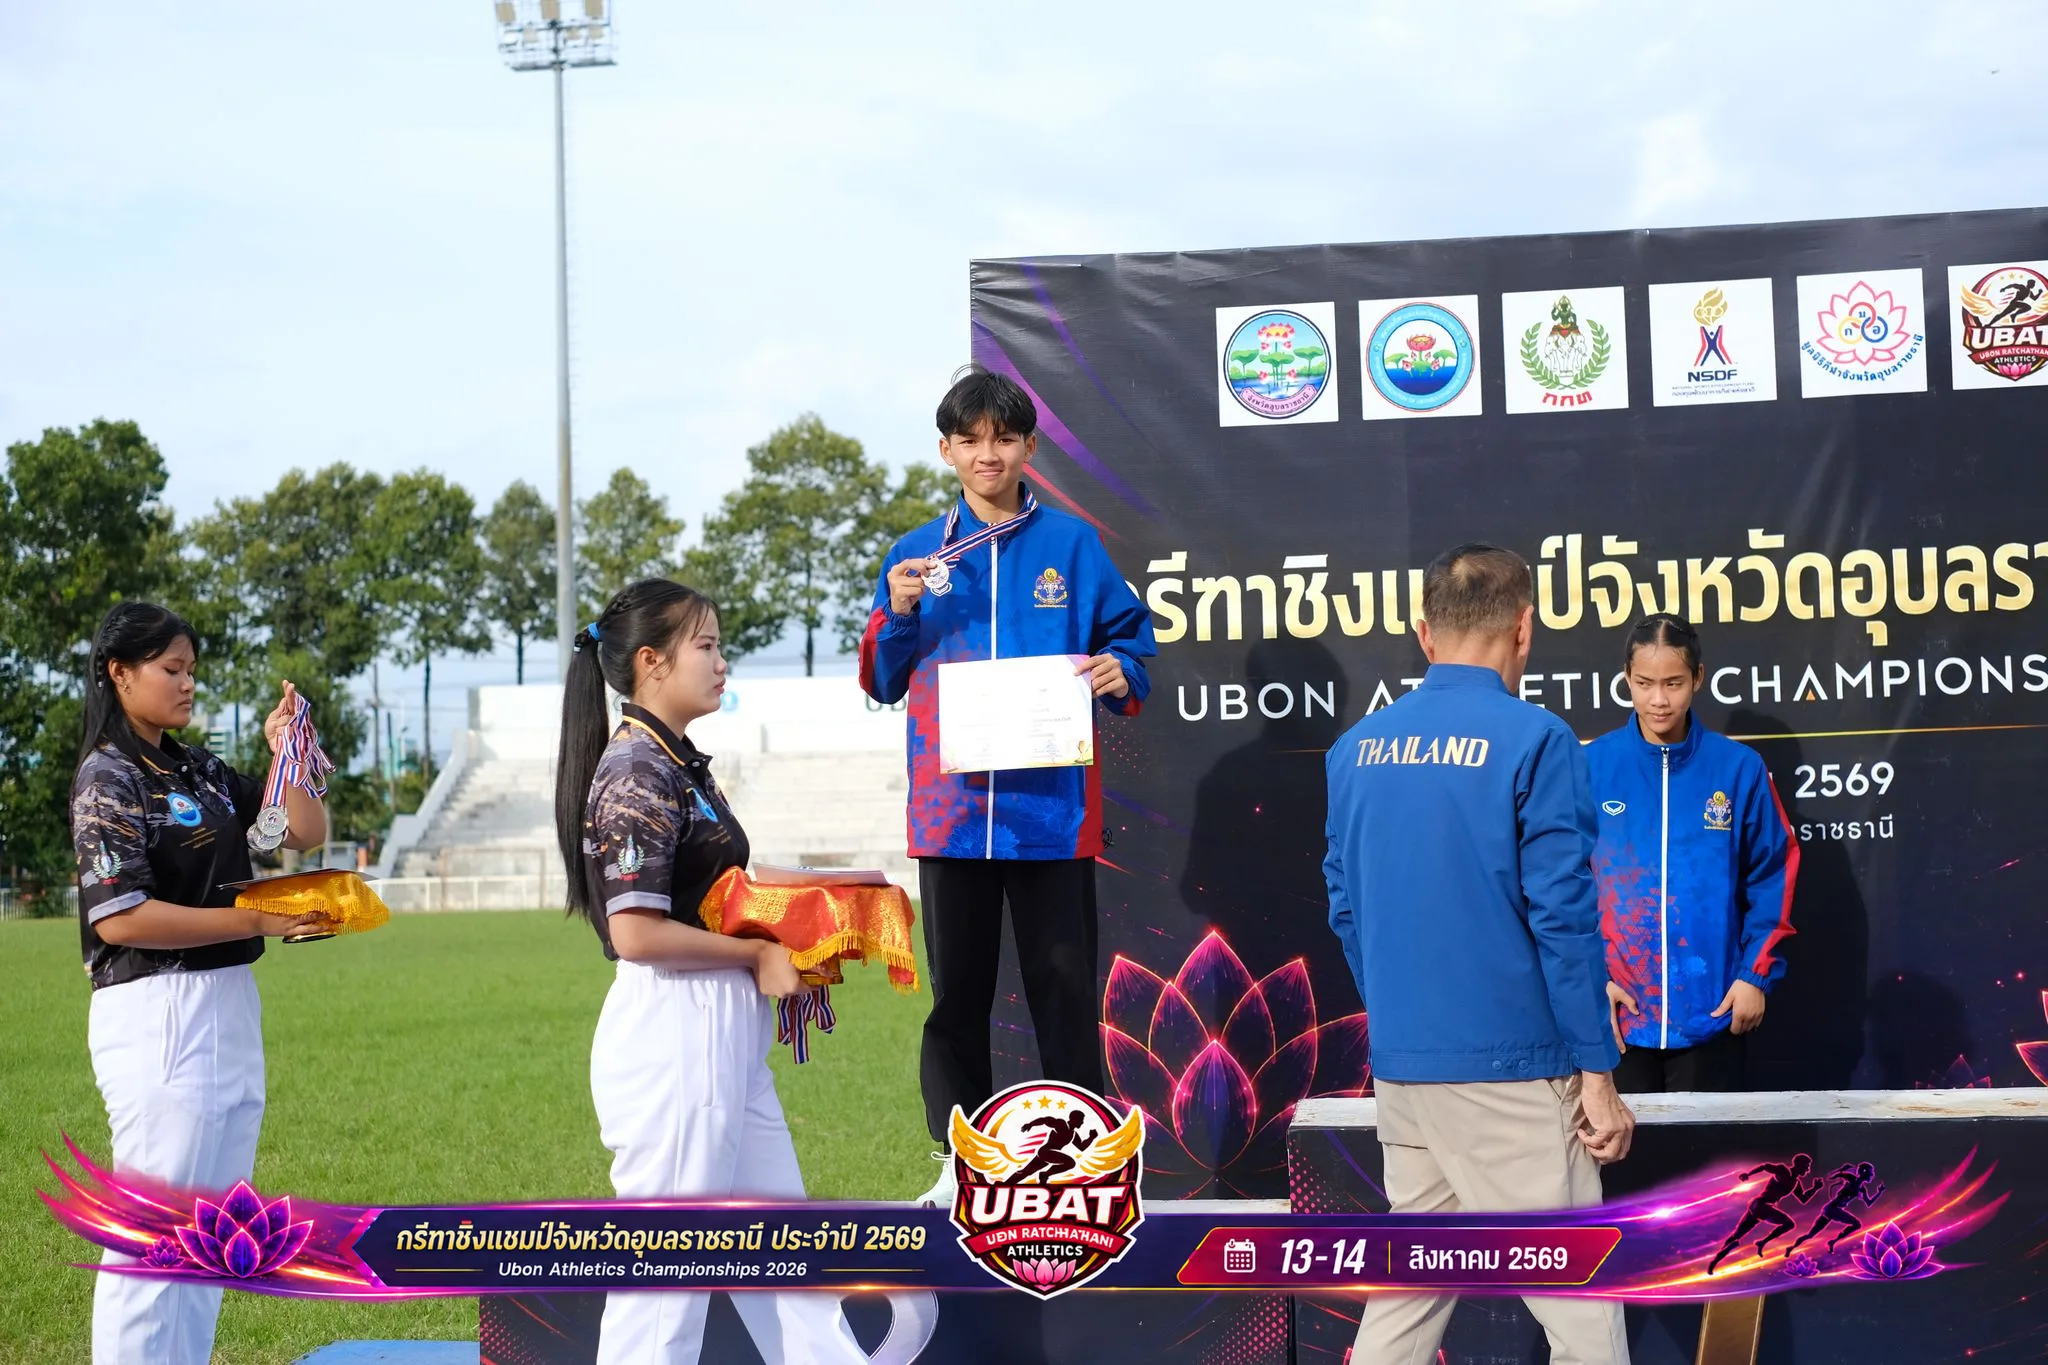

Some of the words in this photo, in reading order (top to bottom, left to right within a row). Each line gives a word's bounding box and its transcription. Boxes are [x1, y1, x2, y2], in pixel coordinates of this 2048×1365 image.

[1971, 325, 2048, 350] UBAT
[1980, 349, 2000, 360] UBON
[1994, 355, 2037, 364] ATHLETICS
[1687, 369, 1738, 382] NSDF
[1542, 391, 1593, 406] กกท
[1178, 681, 1335, 722] UBON
[1710, 653, 2048, 705] CHAMPIONS
[1356, 736, 1490, 767] THAILAND
[1794, 761, 1895, 799] 2569
[1790, 813, 1894, 842] ราชธานี
